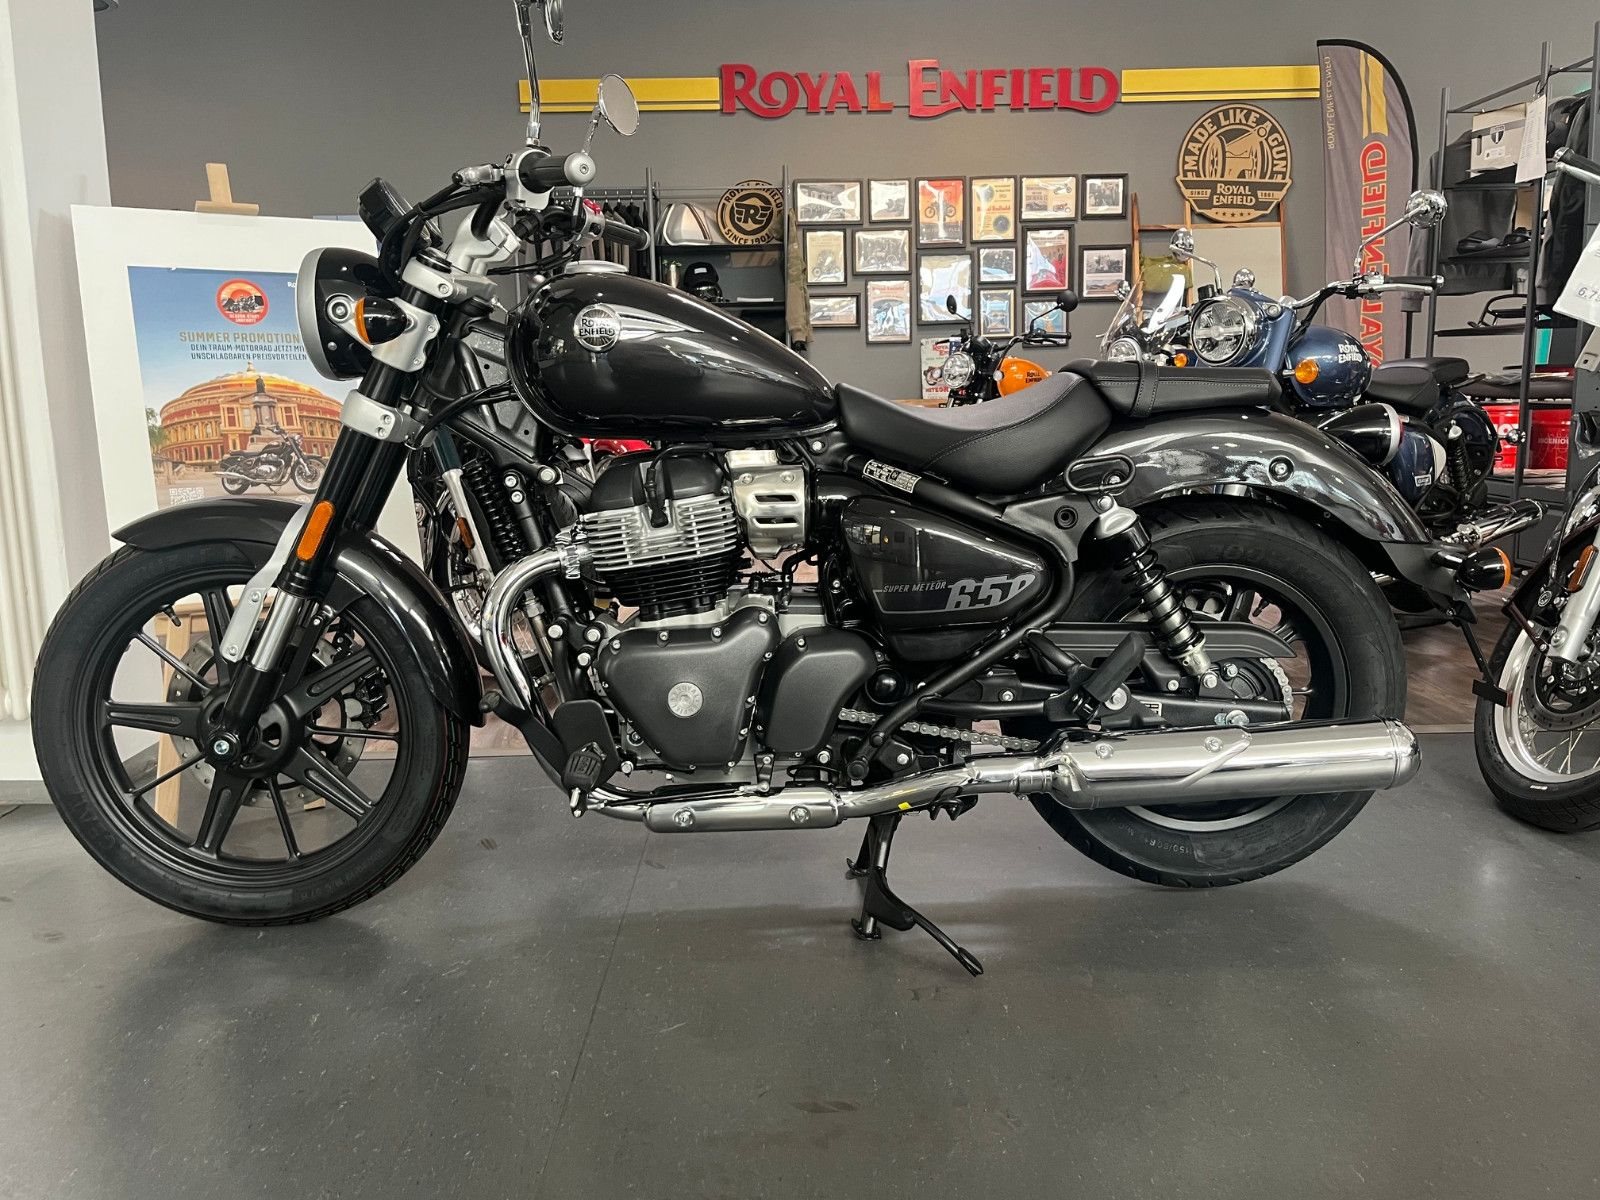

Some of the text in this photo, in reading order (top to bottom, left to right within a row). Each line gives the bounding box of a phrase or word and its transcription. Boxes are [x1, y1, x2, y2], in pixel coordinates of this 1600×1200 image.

[721, 59, 1119, 118] ROYAL ENFIELD
[1184, 118, 1217, 171] MADE
[1218, 108, 1260, 127] LIKE
[1267, 132, 1287, 172] GUN
[1217, 183, 1251, 195] ROYAL
[1213, 195, 1255, 206] ENFIELD
[180, 332, 300, 344] SUMMER PROMOTION
[579, 328, 616, 337] ENFIELD
[190, 352, 251, 360] UNSCHLAGBAREN
[883, 573, 1036, 611] SUPER METEOR 650
